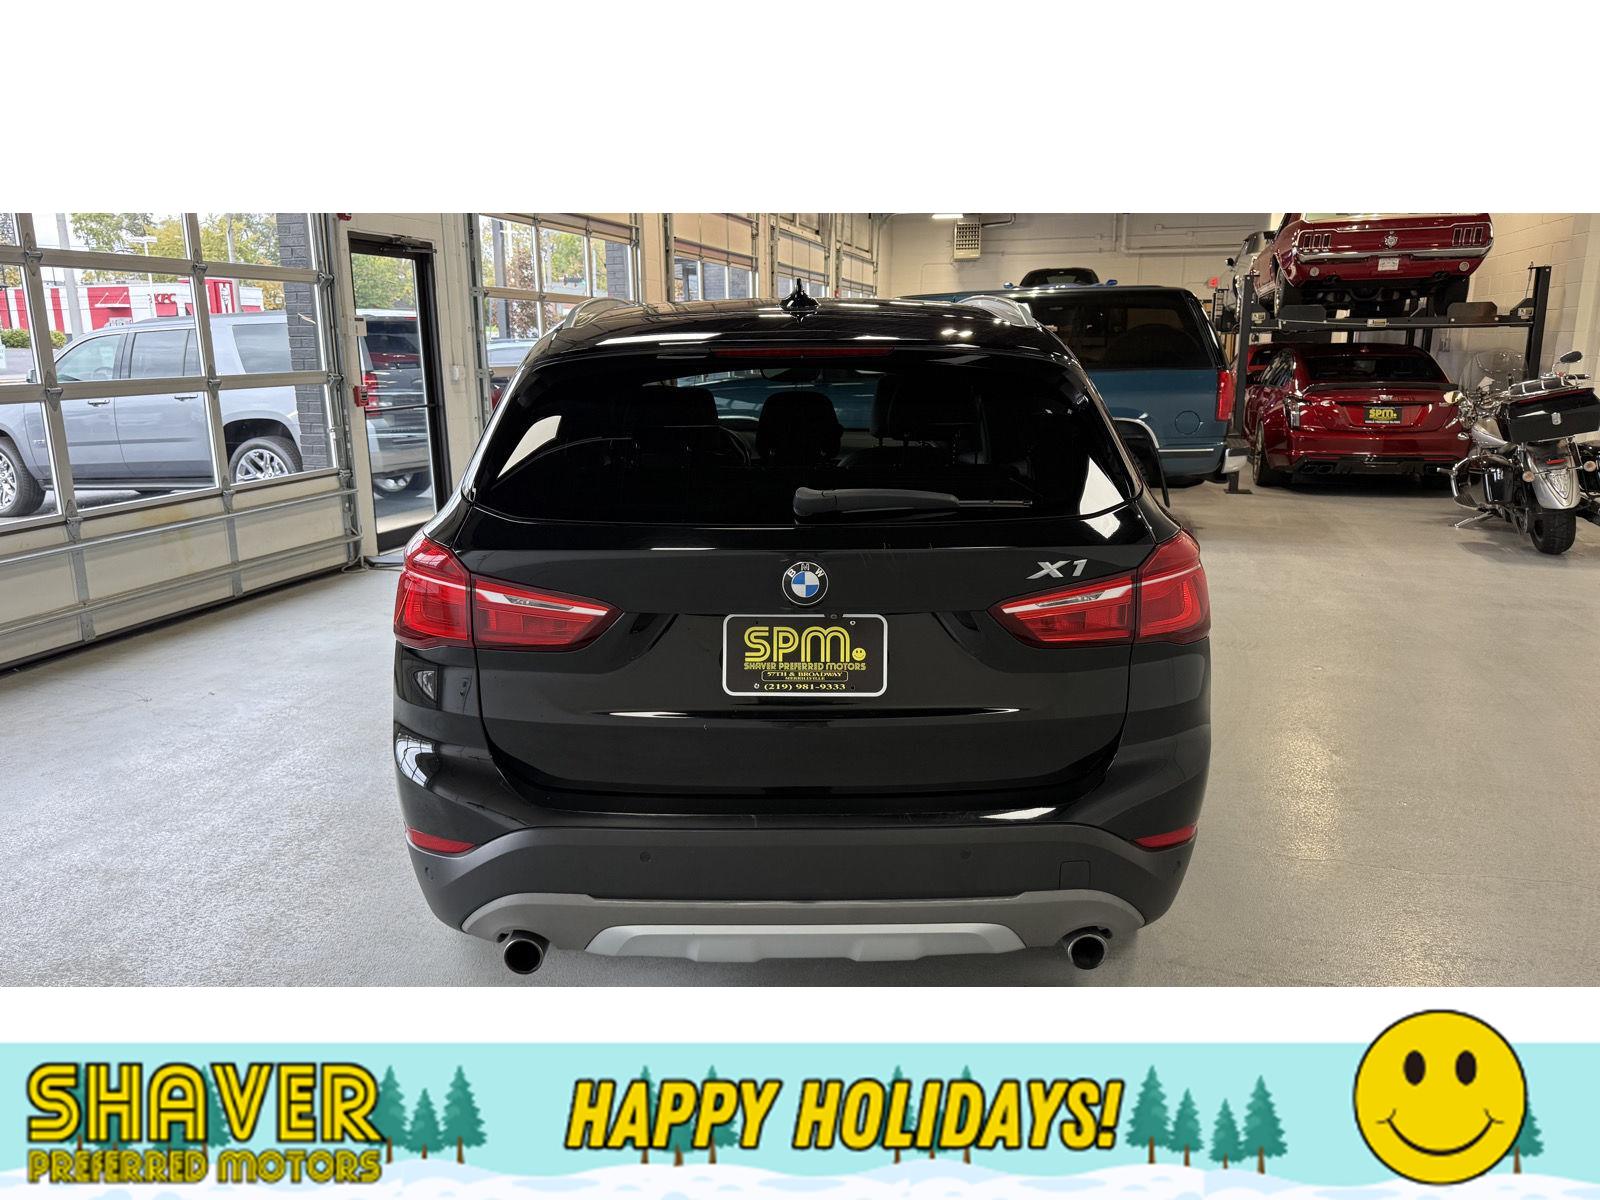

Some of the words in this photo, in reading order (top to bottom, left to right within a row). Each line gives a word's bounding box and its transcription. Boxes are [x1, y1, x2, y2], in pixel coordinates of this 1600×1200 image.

[786, 563, 825, 578] BMW
[1025, 559, 1088, 579] X1
[743, 662, 776, 670] SHAVER
[778, 662, 824, 671] PREFERRED
[826, 662, 867, 671] MOTORS
[764, 683, 793, 691] (219)
